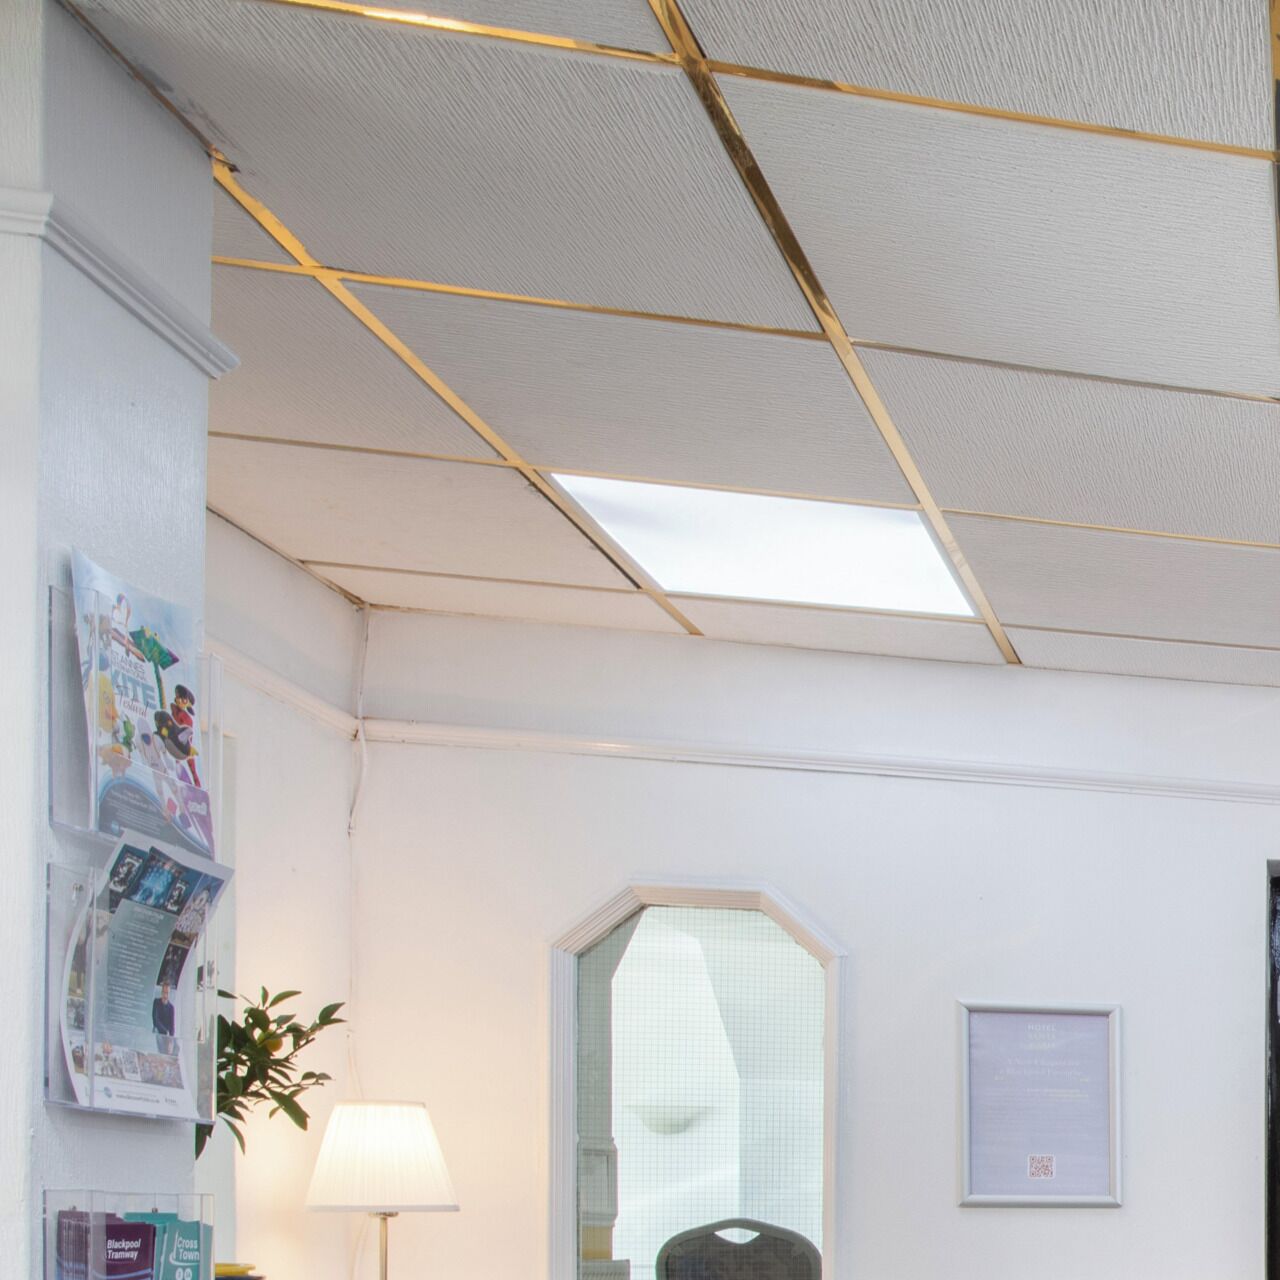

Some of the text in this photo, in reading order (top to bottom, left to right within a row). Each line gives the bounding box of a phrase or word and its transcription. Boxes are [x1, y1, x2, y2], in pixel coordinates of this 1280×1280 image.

[107, 1238, 142, 1251] Blackpool
[177, 1237, 198, 1249] Cross
[107, 1250, 139, 1262] Tramway
[179, 1250, 200, 1260] Town
